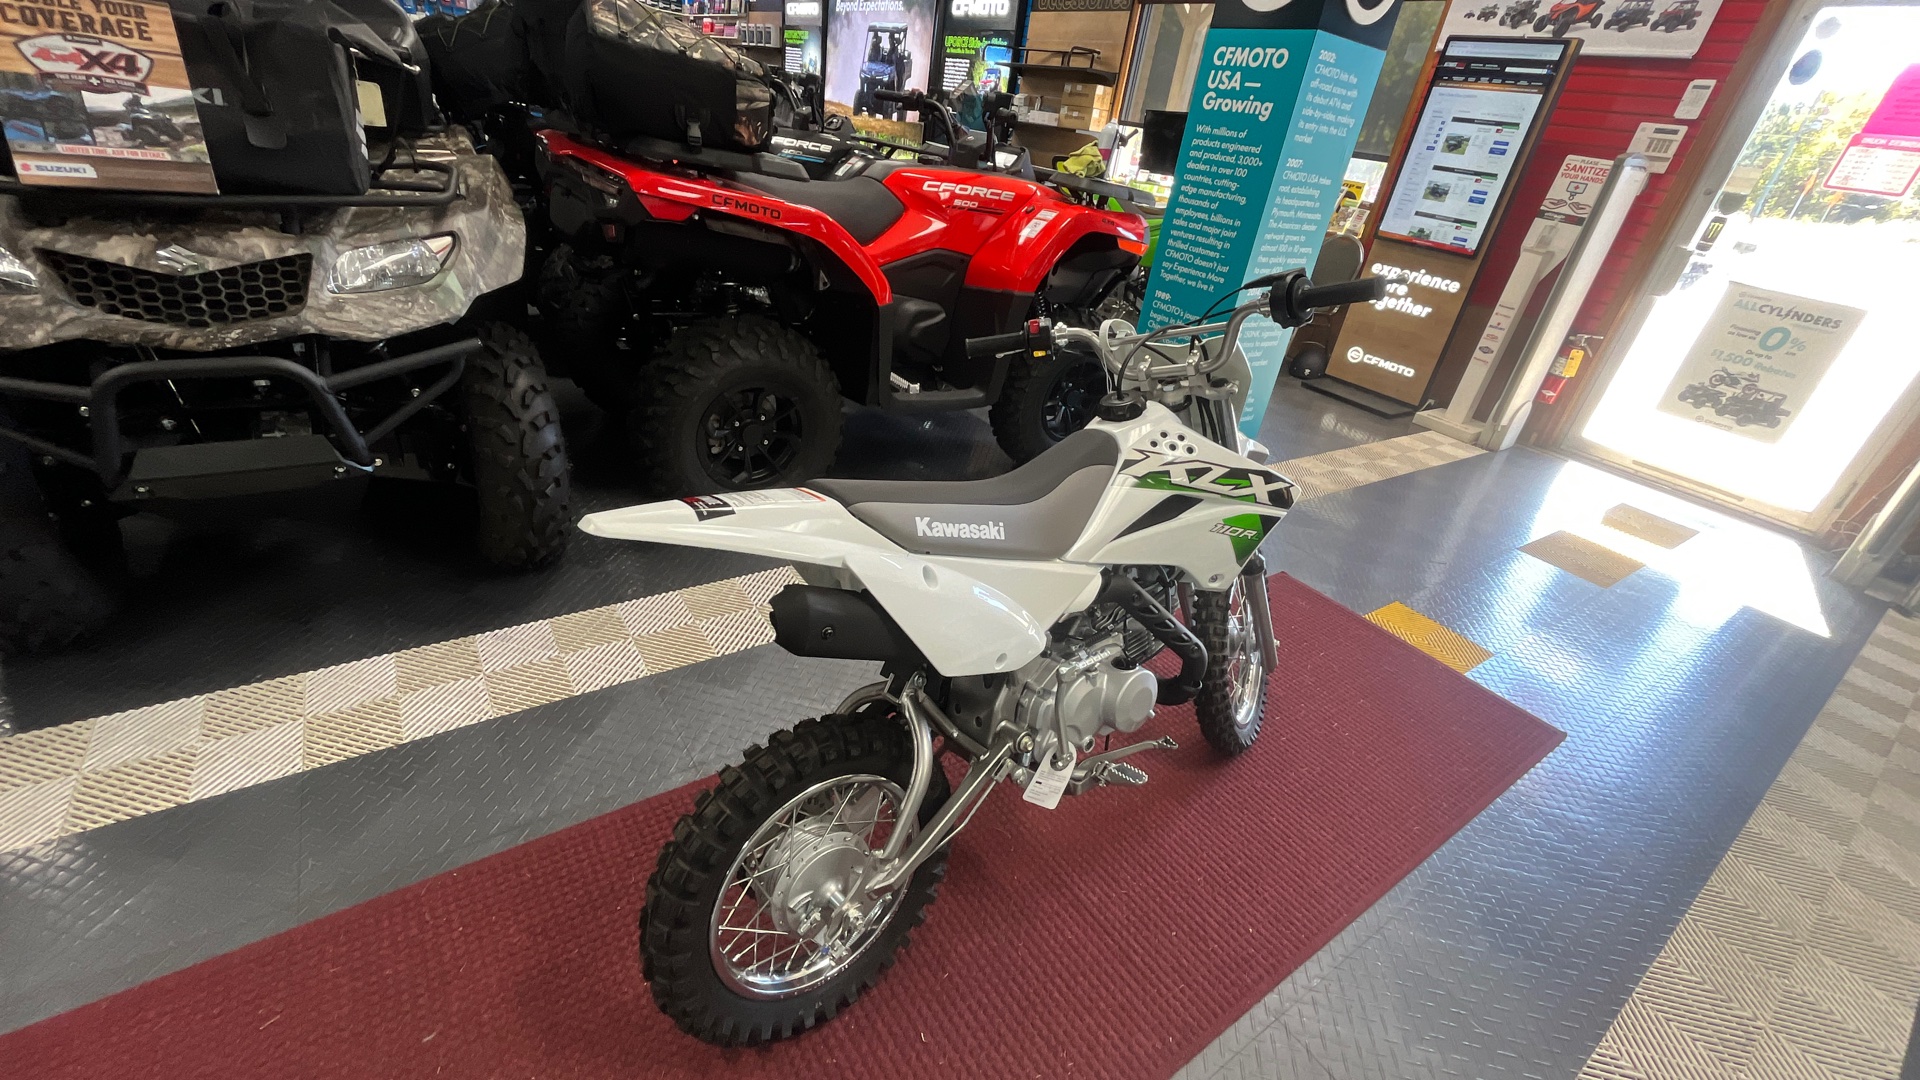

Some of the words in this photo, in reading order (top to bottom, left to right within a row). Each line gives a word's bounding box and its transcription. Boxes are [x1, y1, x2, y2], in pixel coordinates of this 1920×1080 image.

[90, 0, 147, 20] YOUR
[836, 0, 859, 15] Beyond
[0, 2, 153, 41] COVERAGE
[1213, 46, 1289, 68] CFMOTO
[1318, 50, 1336, 64] 2002:
[1208, 70, 1241, 90] USA
[1314, 64, 1340, 79] CFMOTO
[1340, 72, 1348, 82] hits
[1348, 73, 1358, 84] the
[1310, 78, 1333, 92] off-road
[1332, 87, 1346, 96] scene
[1348, 88, 1358, 98] with
[1202, 91, 1274, 122] Growing
[1313, 95, 1328, 106] debut
[1341, 102, 1353, 111] and
[1305, 122, 1318, 133] entry
[1318, 124, 1328, 134] into
[1328, 125, 1338, 135] the
[1336, 114, 1356, 128] making
[1196, 124, 1211, 134] With
[1212, 127, 1237, 138] millions
[1238, 129, 1248, 138] of
[771, 136, 832, 152] FORCE
[1191, 138, 1220, 148] products
[1221, 142, 1262, 154] engineered
[1189, 150, 1202, 158] and
[1237, 156, 1263, 166] 3,000+
[1286, 158, 1304, 168] 2007:
[34, 164, 87, 174] SUZUKI
[1186, 160, 1210, 172] dealers
[1211, 164, 1218, 172] in
[1218, 167, 1234, 176] over
[1234, 167, 1248, 178] 100
[1564, 162, 1610, 177] SANITIZE
[1214, 179, 1240, 191] cutting-
[1282, 170, 1307, 183] CFMOTO
[1307, 174, 1319, 184] USA
[1319, 176, 1332, 186] takes
[1560, 172, 1580, 180] YOUR
[1580, 176, 1604, 184] HANDS
[922, 180, 1016, 202] CFORCE
[1180, 184, 1198, 194] edge
[1290, 185, 1320, 198] establishing
[711, 193, 782, 222] CFMOTO
[953, 199, 978, 209] 500
[1178, 195, 1210, 208] thousands
[1210, 200, 1220, 210] of
[1282, 196, 1317, 208] headquarters
[1210, 212, 1234, 226] billions
[1234, 218, 1241, 227] in
[1268, 220, 1277, 228] The
[1276, 220, 1301, 230] American
[1301, 222, 1318, 232] dealer
[1172, 218, 1188, 228] sales
[1188, 220, 1201, 230] and
[1202, 224, 1222, 236] major
[1220, 228, 1236, 238] joint
[1170, 229, 1195, 240] ventures
[1196, 236, 1224, 249] resulting
[1224, 240, 1230, 249] in
[1264, 232, 1284, 240] network
[1284, 234, 1300, 244] grows
[1300, 234, 1306, 242] to
[1167, 239, 1188, 250] thrilled
[1189, 246, 1220, 258] customers
[1261, 243, 1278, 252] almost
[1279, 244, 1288, 252] 100
[1165, 248, 1194, 263] CFMOTO
[1194, 258, 1216, 269] doesn't
[1216, 264, 1230, 274] just
[1270, 254, 1286, 264] quickly
[1286, 256, 1307, 264] expands
[1162, 261, 1172, 270] say
[1173, 262, 1206, 278] Experience
[1207, 272, 1225, 284] More
[1187, 280, 1196, 288] we
[1197, 280, 1208, 290] live
[1154, 290, 1172, 302] 1989:
[1150, 310, 1168, 323] begins
[1152, 300, 1184, 317] CFMOTO's
[1363, 354, 1416, 378] CFMOTO
[1118, 448, 1296, 506] KLX
[914, 516, 1006, 540] Kawasaki
